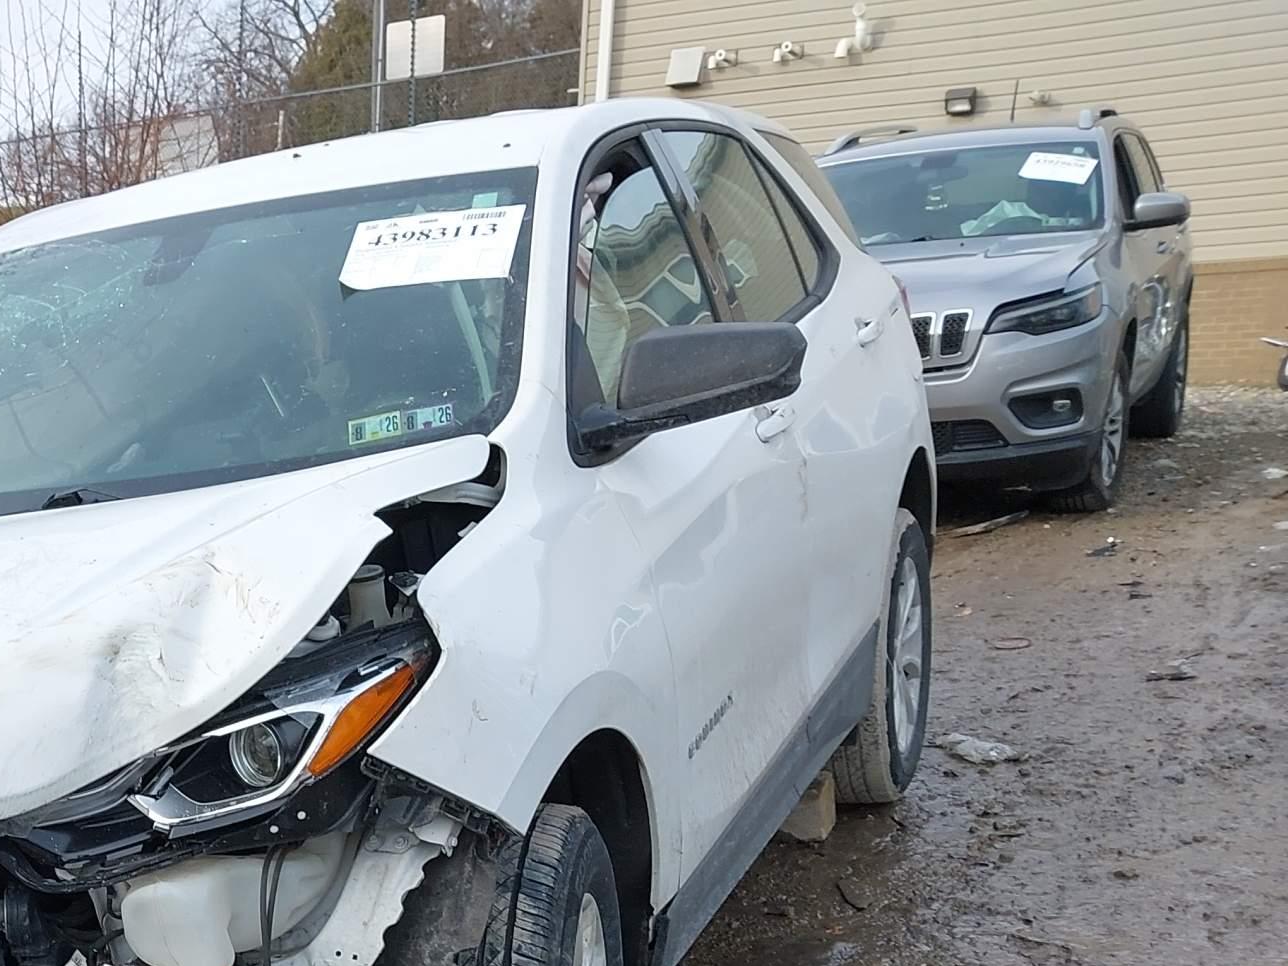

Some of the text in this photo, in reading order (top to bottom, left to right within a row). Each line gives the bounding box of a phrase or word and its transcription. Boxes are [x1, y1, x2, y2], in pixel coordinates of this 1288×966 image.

[368, 223, 498, 246] 43983113
[385, 415, 399, 433] 26
[438, 406, 452, 424] 26
